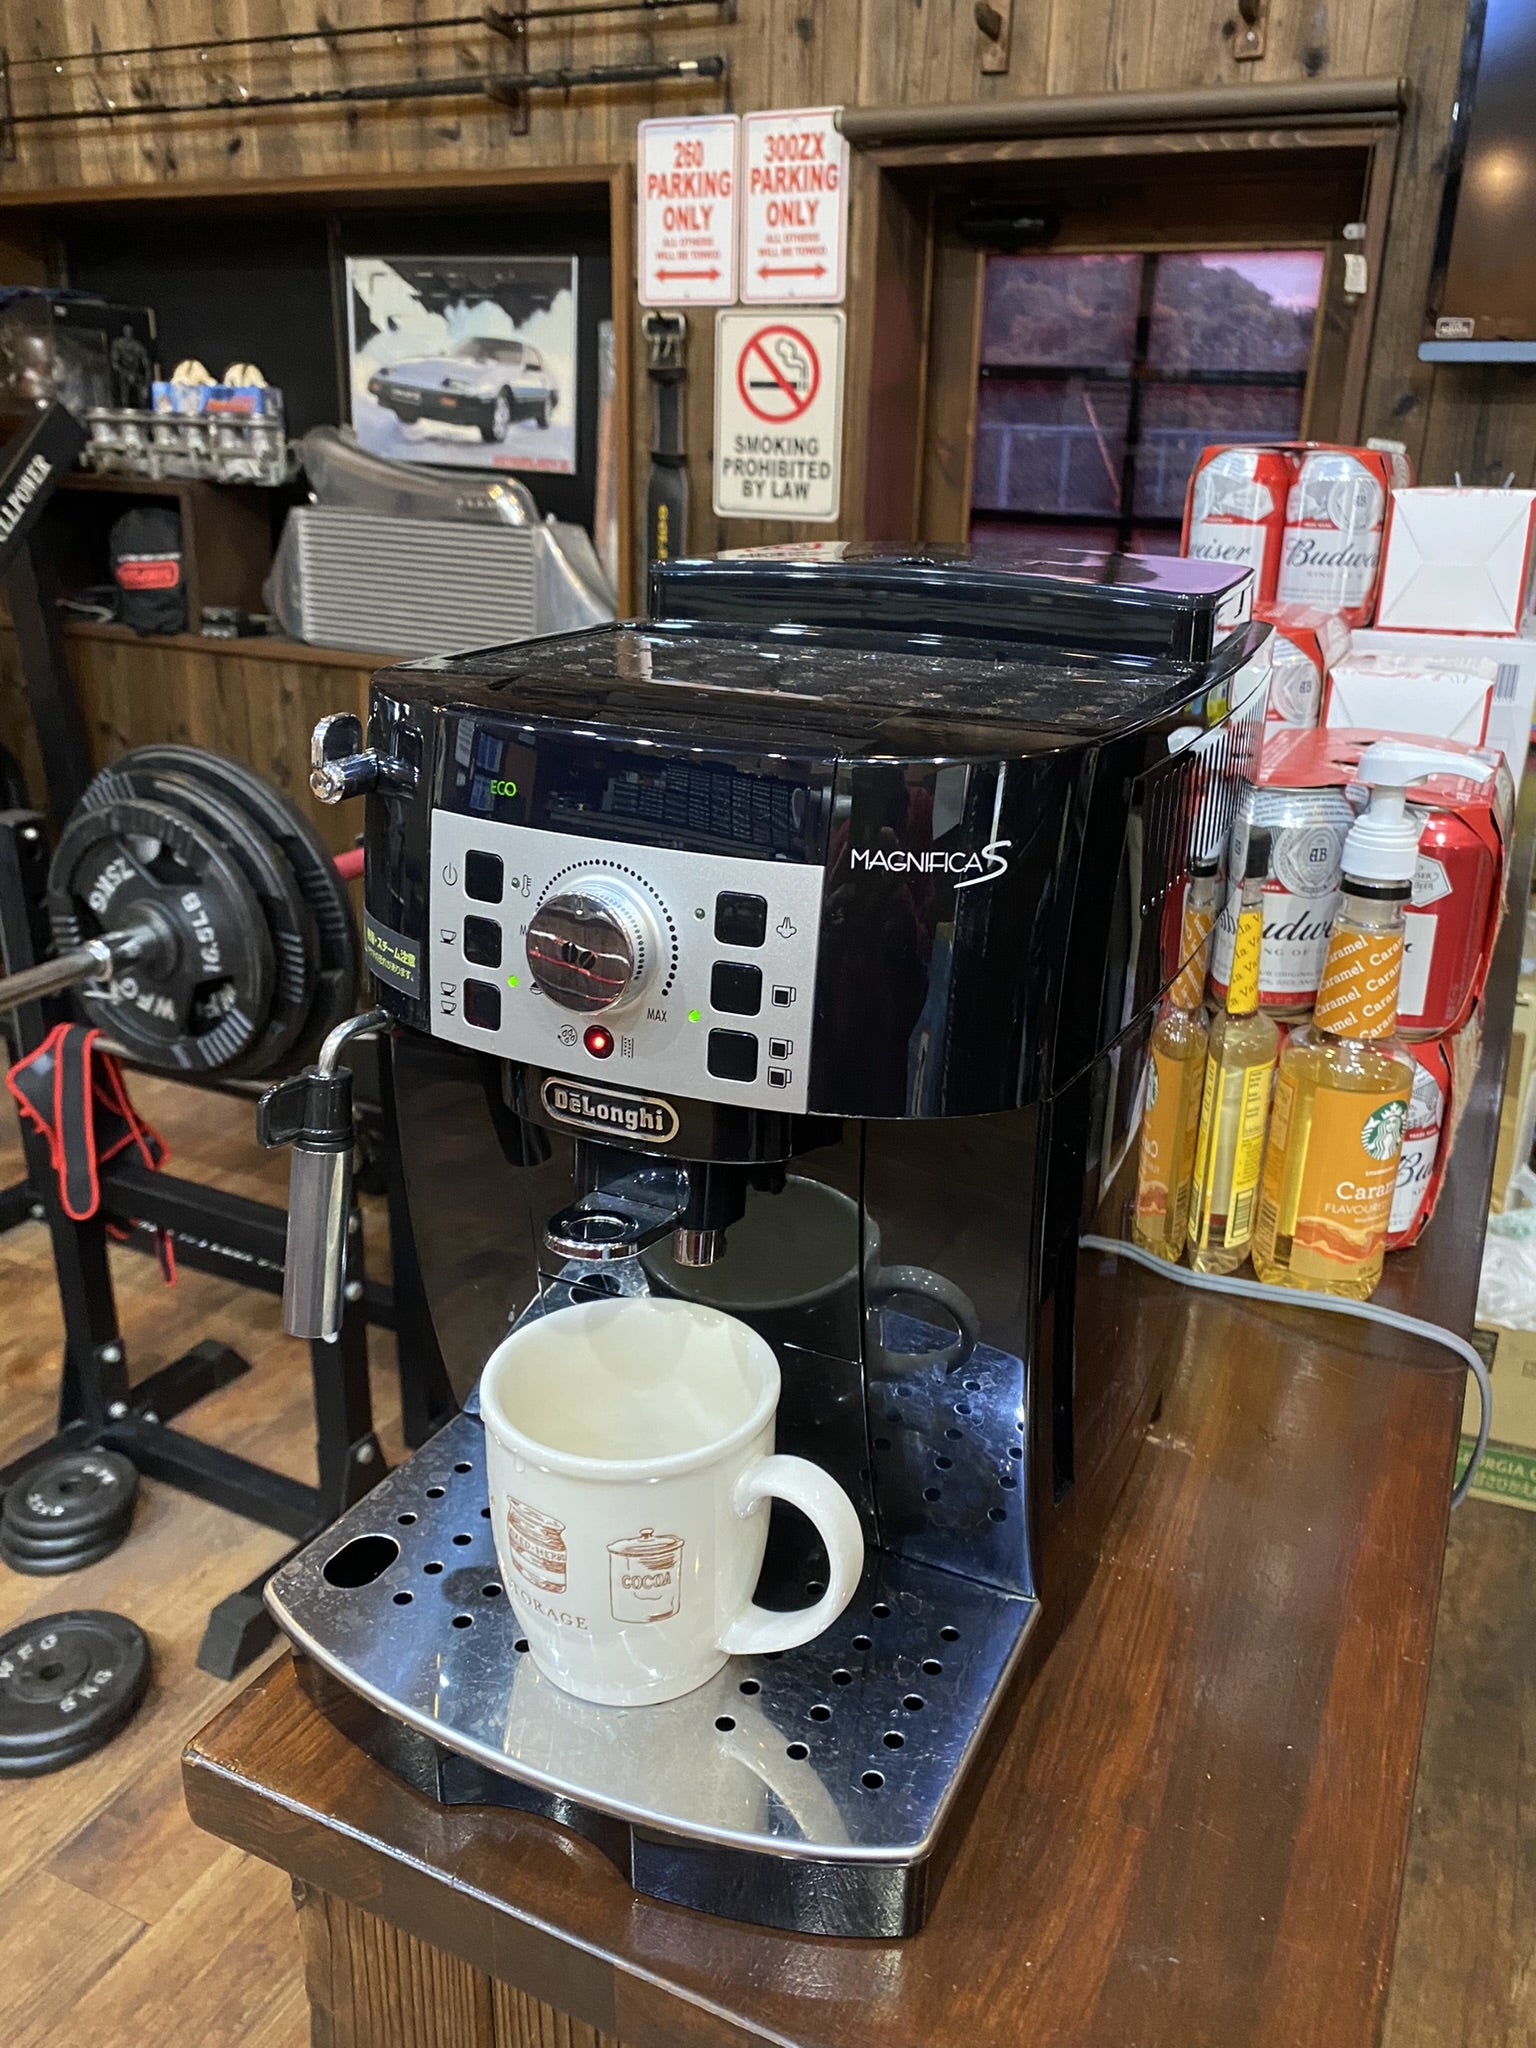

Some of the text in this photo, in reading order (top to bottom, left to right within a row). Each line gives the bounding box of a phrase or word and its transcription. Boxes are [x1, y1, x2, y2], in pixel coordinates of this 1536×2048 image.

[674, 140, 704, 168] 260
[765, 132, 825, 163] 300ZX
[648, 171, 731, 199] PARKING
[752, 164, 838, 193] PARKING
[663, 204, 713, 231] ONLY
[767, 200, 819, 226] ONLY
[735, 435, 819, 456] SMOKING
[723, 458, 831, 479] PROHIBITED
[743, 481, 811, 499] BY LAW
[490, 779, 518, 797] ECO
[850, 848, 984, 873] MAGNIFICA
[646, 1007, 668, 1023] MAX
[621, 1571, 673, 1591] COCOA
